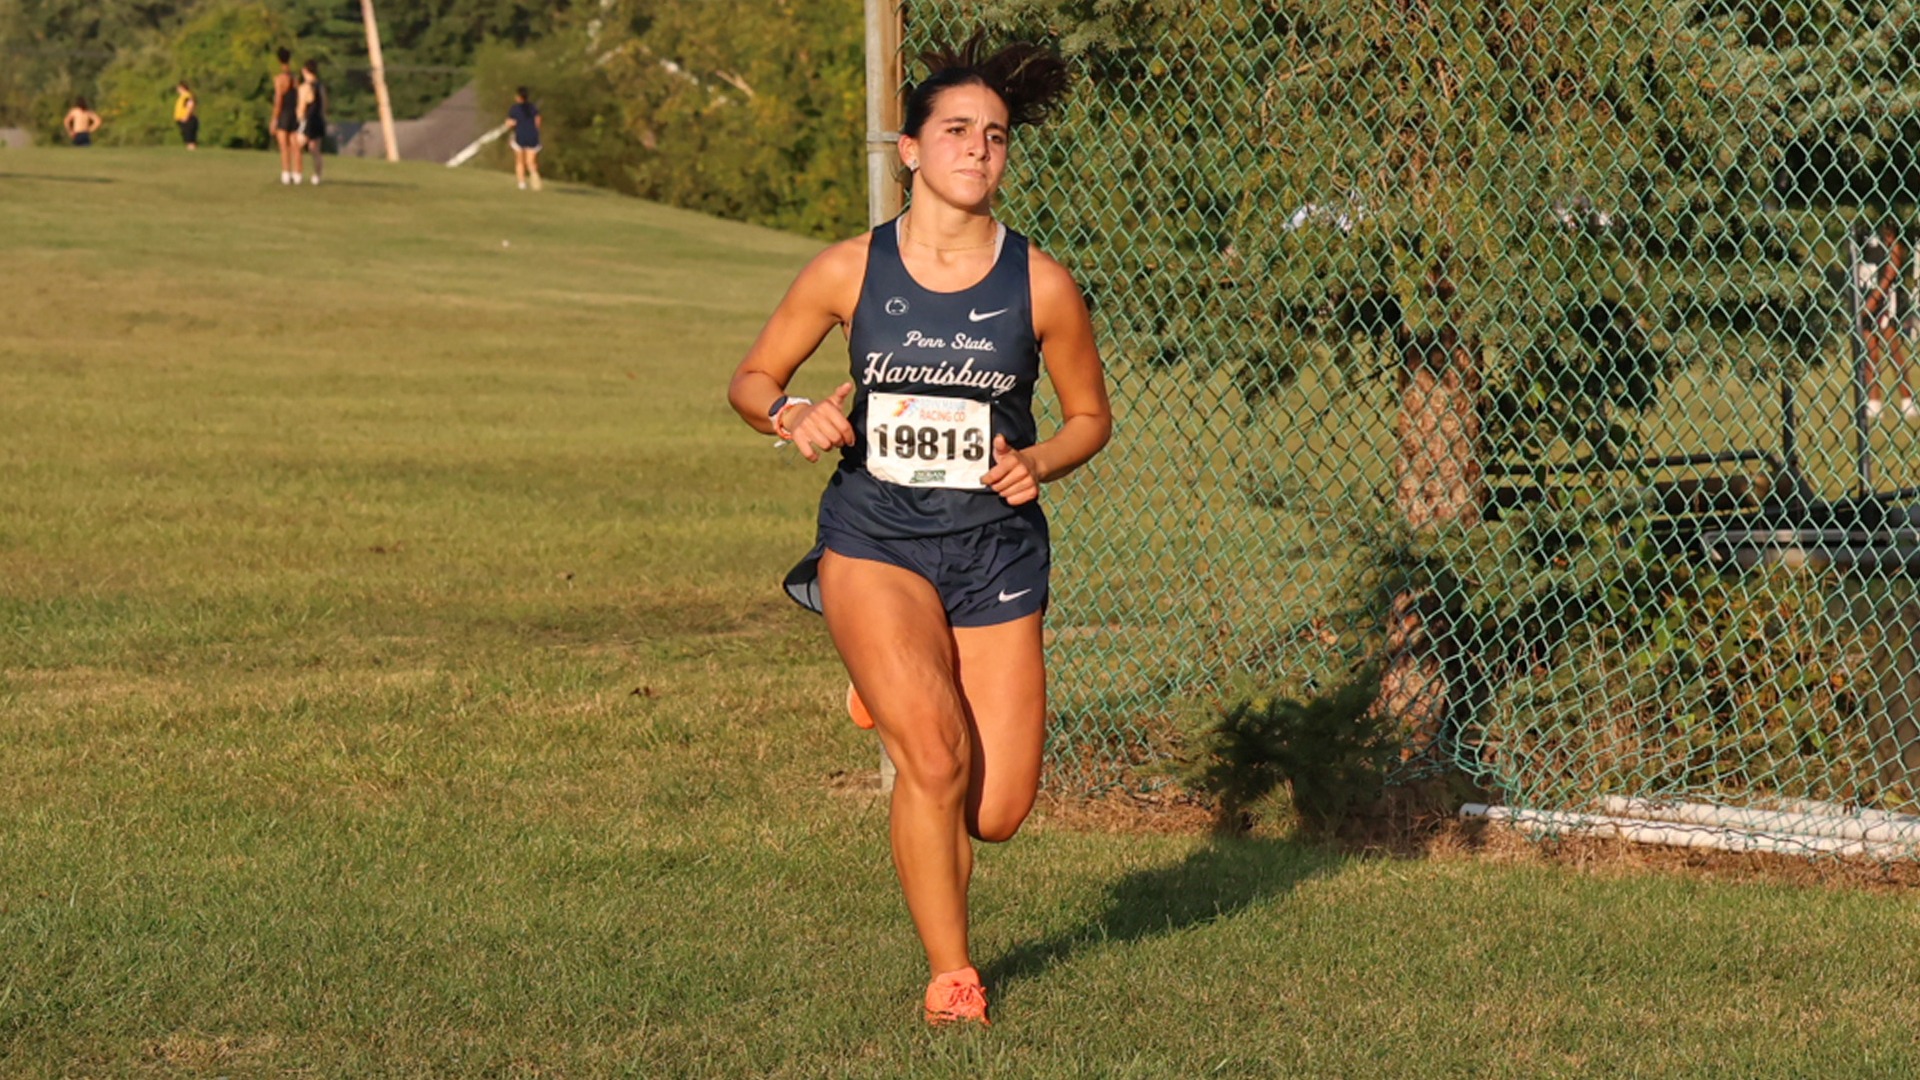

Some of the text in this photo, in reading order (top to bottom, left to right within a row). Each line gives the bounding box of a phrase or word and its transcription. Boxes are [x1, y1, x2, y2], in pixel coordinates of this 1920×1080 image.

[903, 330, 994, 352] Penn State
[862, 352, 1016, 397] Harrisburg
[873, 423, 985, 462] 19813
